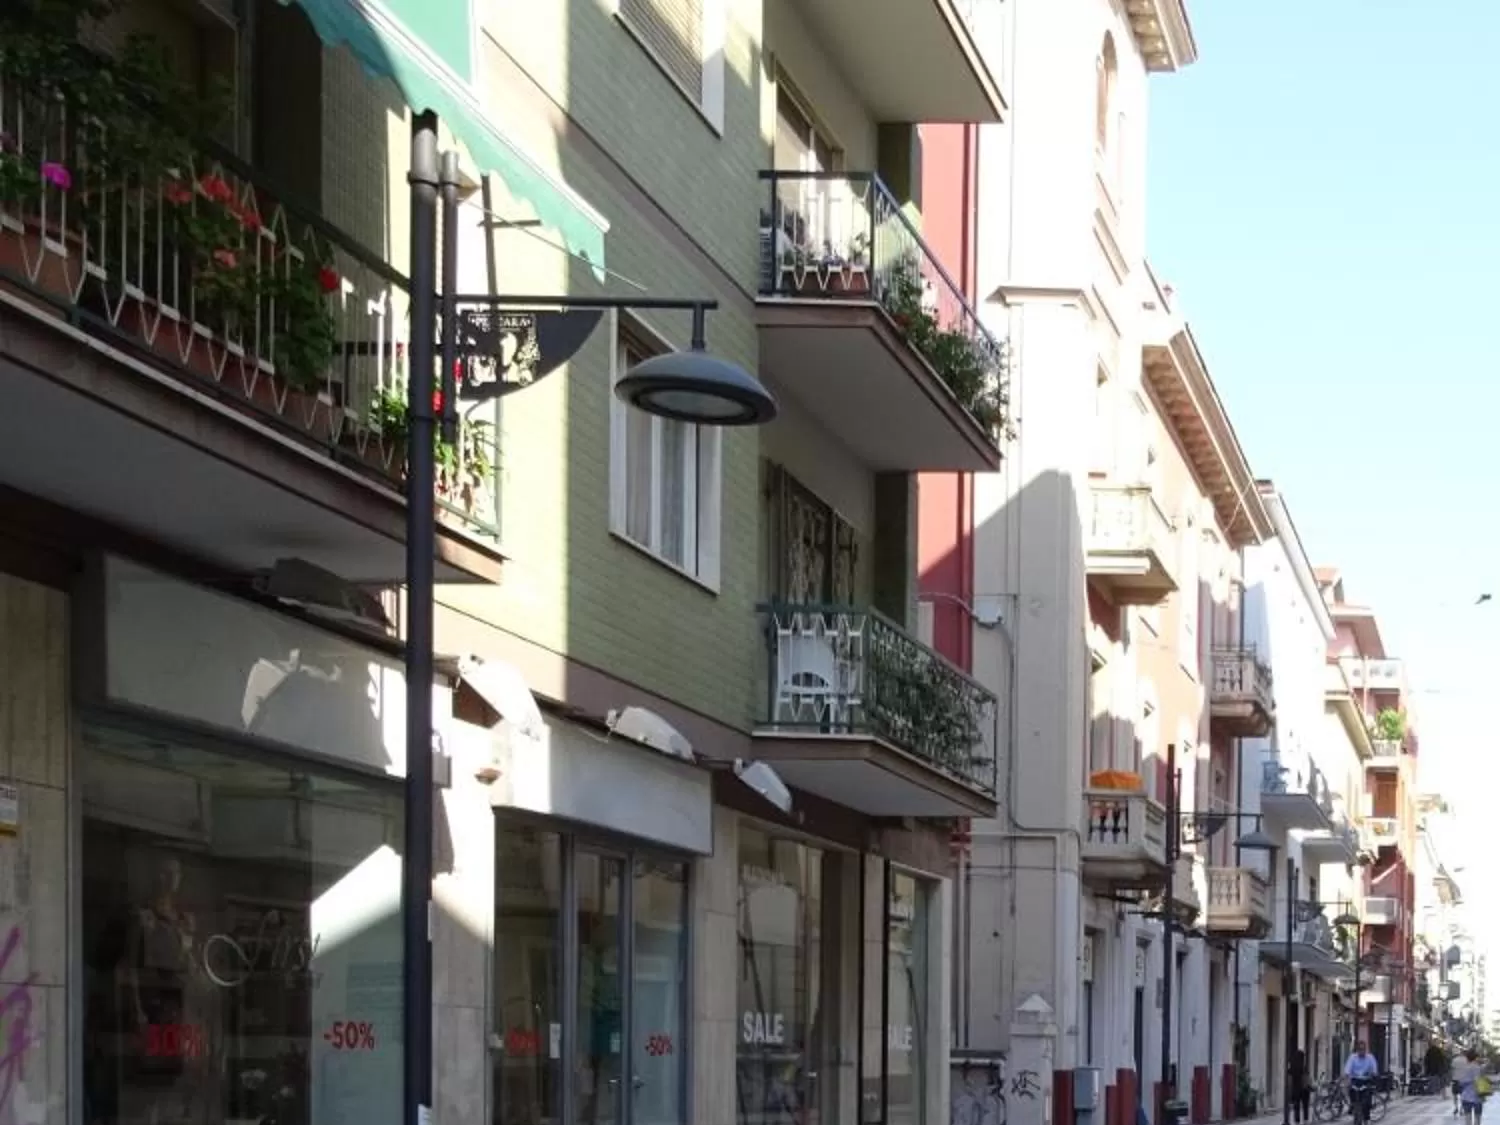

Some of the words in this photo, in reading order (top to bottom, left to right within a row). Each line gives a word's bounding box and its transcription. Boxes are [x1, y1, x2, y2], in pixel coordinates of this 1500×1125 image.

[324, 1020, 375, 1051] -50%
[743, 1010, 785, 1043] SALE
[645, 1034, 673, 1056] -50%
